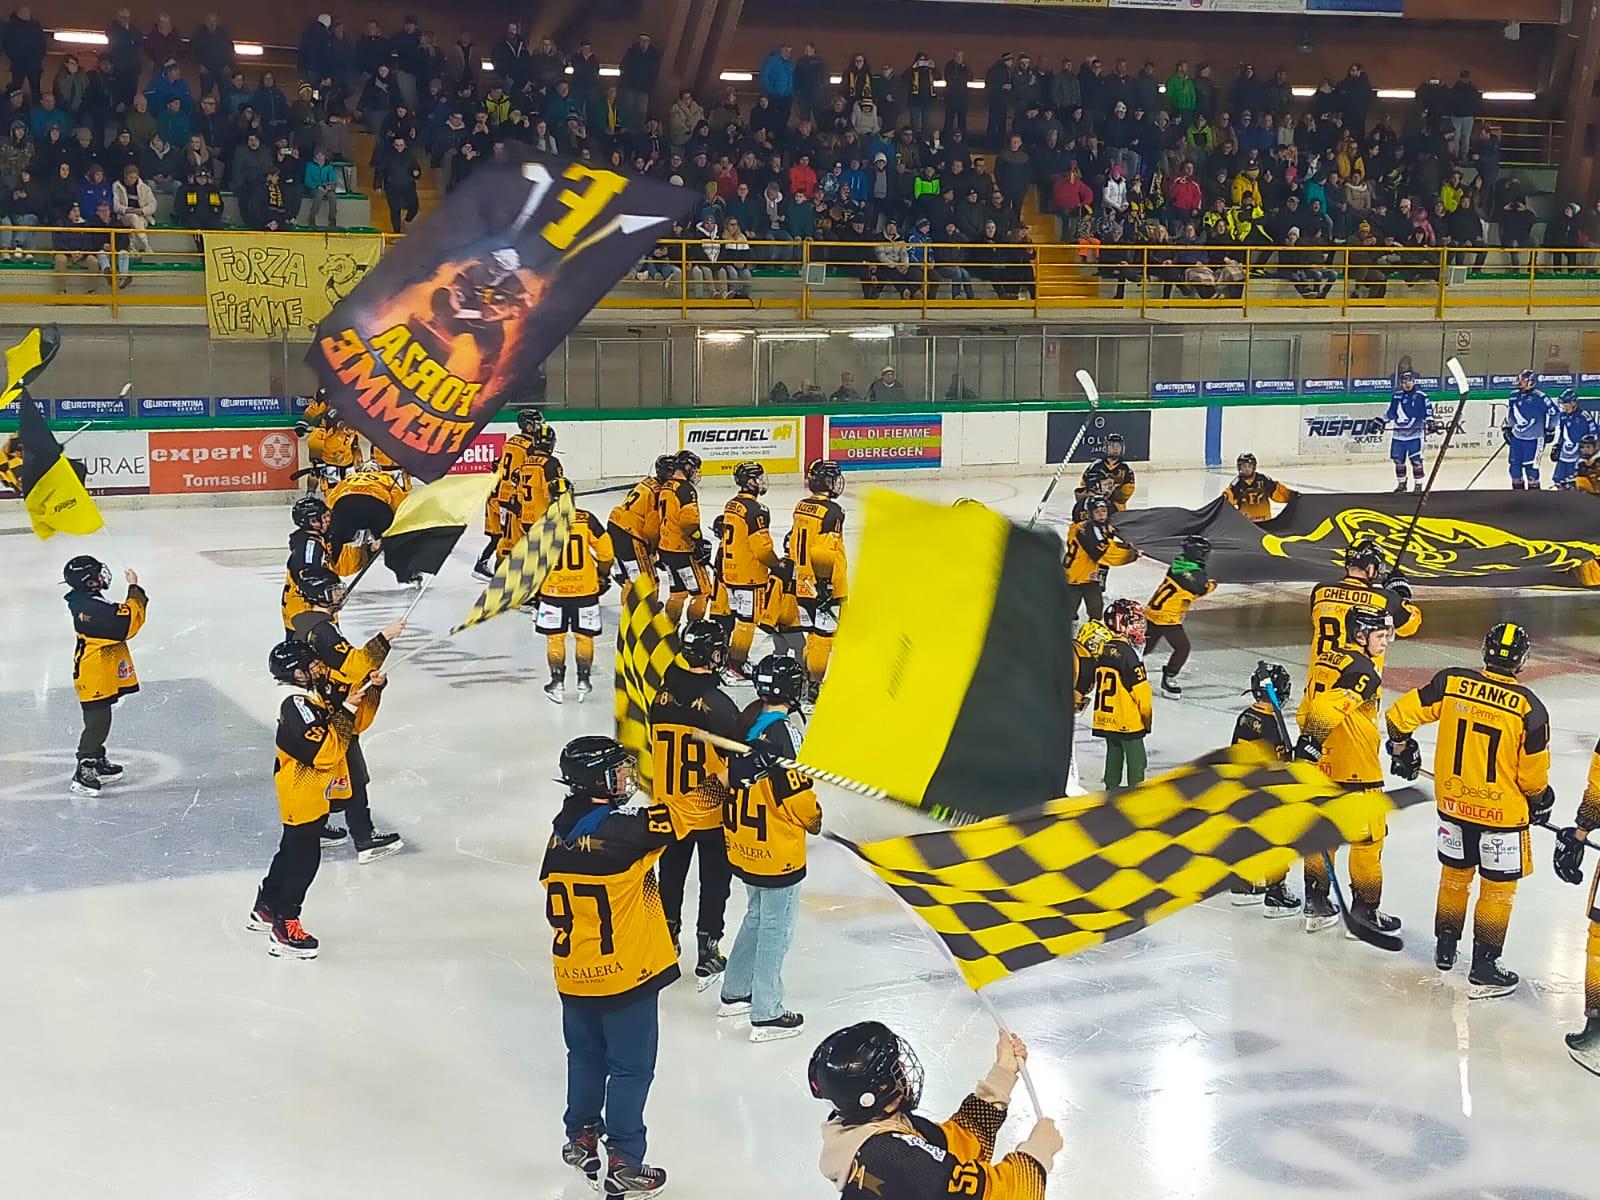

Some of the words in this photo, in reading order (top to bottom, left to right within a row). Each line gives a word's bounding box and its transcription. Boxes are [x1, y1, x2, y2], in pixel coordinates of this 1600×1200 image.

[212, 246, 308, 288] FORZA
[687, 429, 769, 443] MISCONEL
[840, 430, 863, 439] VAL
[868, 429, 879, 439] DI
[884, 428, 931, 438] FIEMME
[151, 444, 253, 463] expert
[847, 447, 923, 458] OBEREGGEN
[182, 471, 268, 487] Tomaselli
[1323, 588, 1373, 605] CHELODI
[1354, 674, 1370, 693] 5
[1458, 680, 1521, 709] STANKO
[1453, 718, 1503, 783] 17
[656, 731, 706, 796] 78
[572, 961, 624, 980] SALERA
